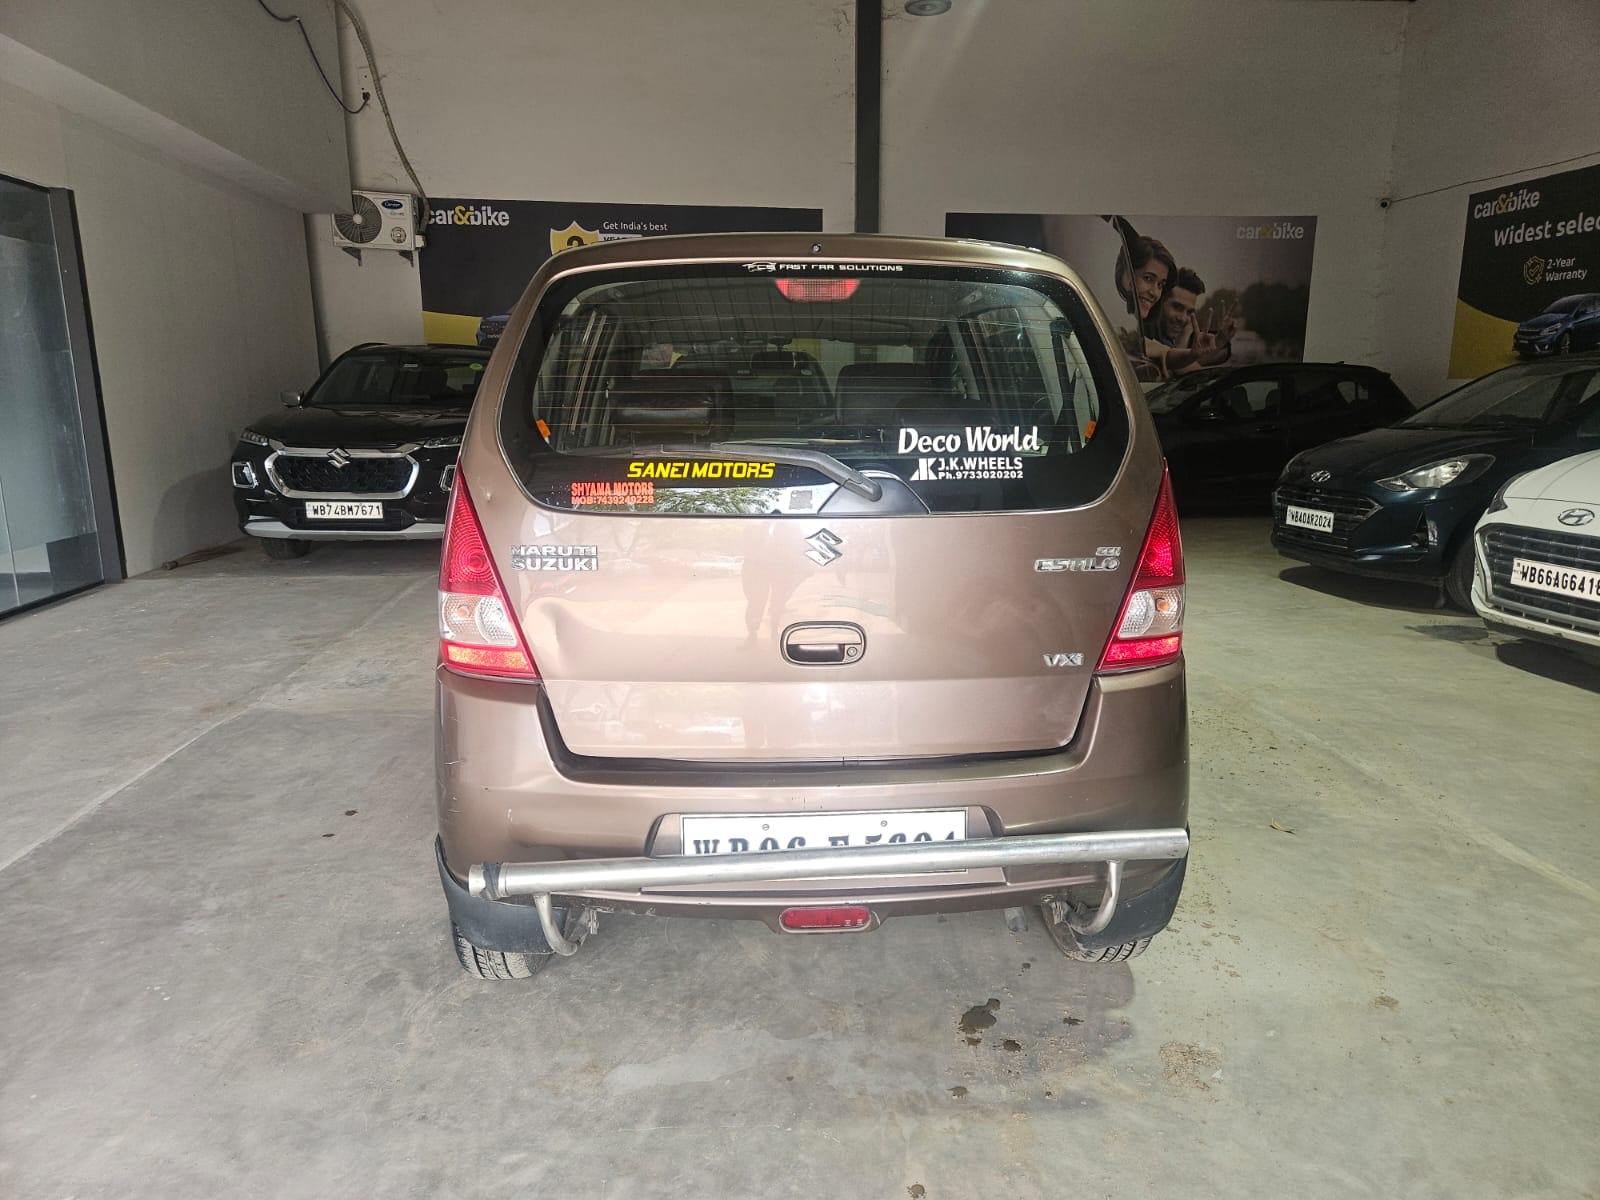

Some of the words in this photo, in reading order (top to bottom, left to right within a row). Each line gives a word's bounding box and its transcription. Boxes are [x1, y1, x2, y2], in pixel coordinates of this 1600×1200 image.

[1474, 188, 1540, 219] car&bike
[603, 221, 618, 230] Get
[620, 221, 647, 230] India's
[649, 223, 668, 231] best
[1494, 221, 1551, 247] Widest
[839, 264, 903, 272] SOLUTIONS
[1547, 257, 1576, 269] 2-Year
[1545, 269, 1588, 282] Warranty
[898, 428, 961, 454] Deco
[965, 426, 1040, 452] World
[627, 461, 691, 478] SANEI
[691, 462, 776, 478] MOTORS
[571, 482, 611, 496] SHYAMA
[613, 482, 654, 496] MOTORS
[511, 545, 598, 556] MARUTI
[511, 558, 598, 571] SUZUKI
